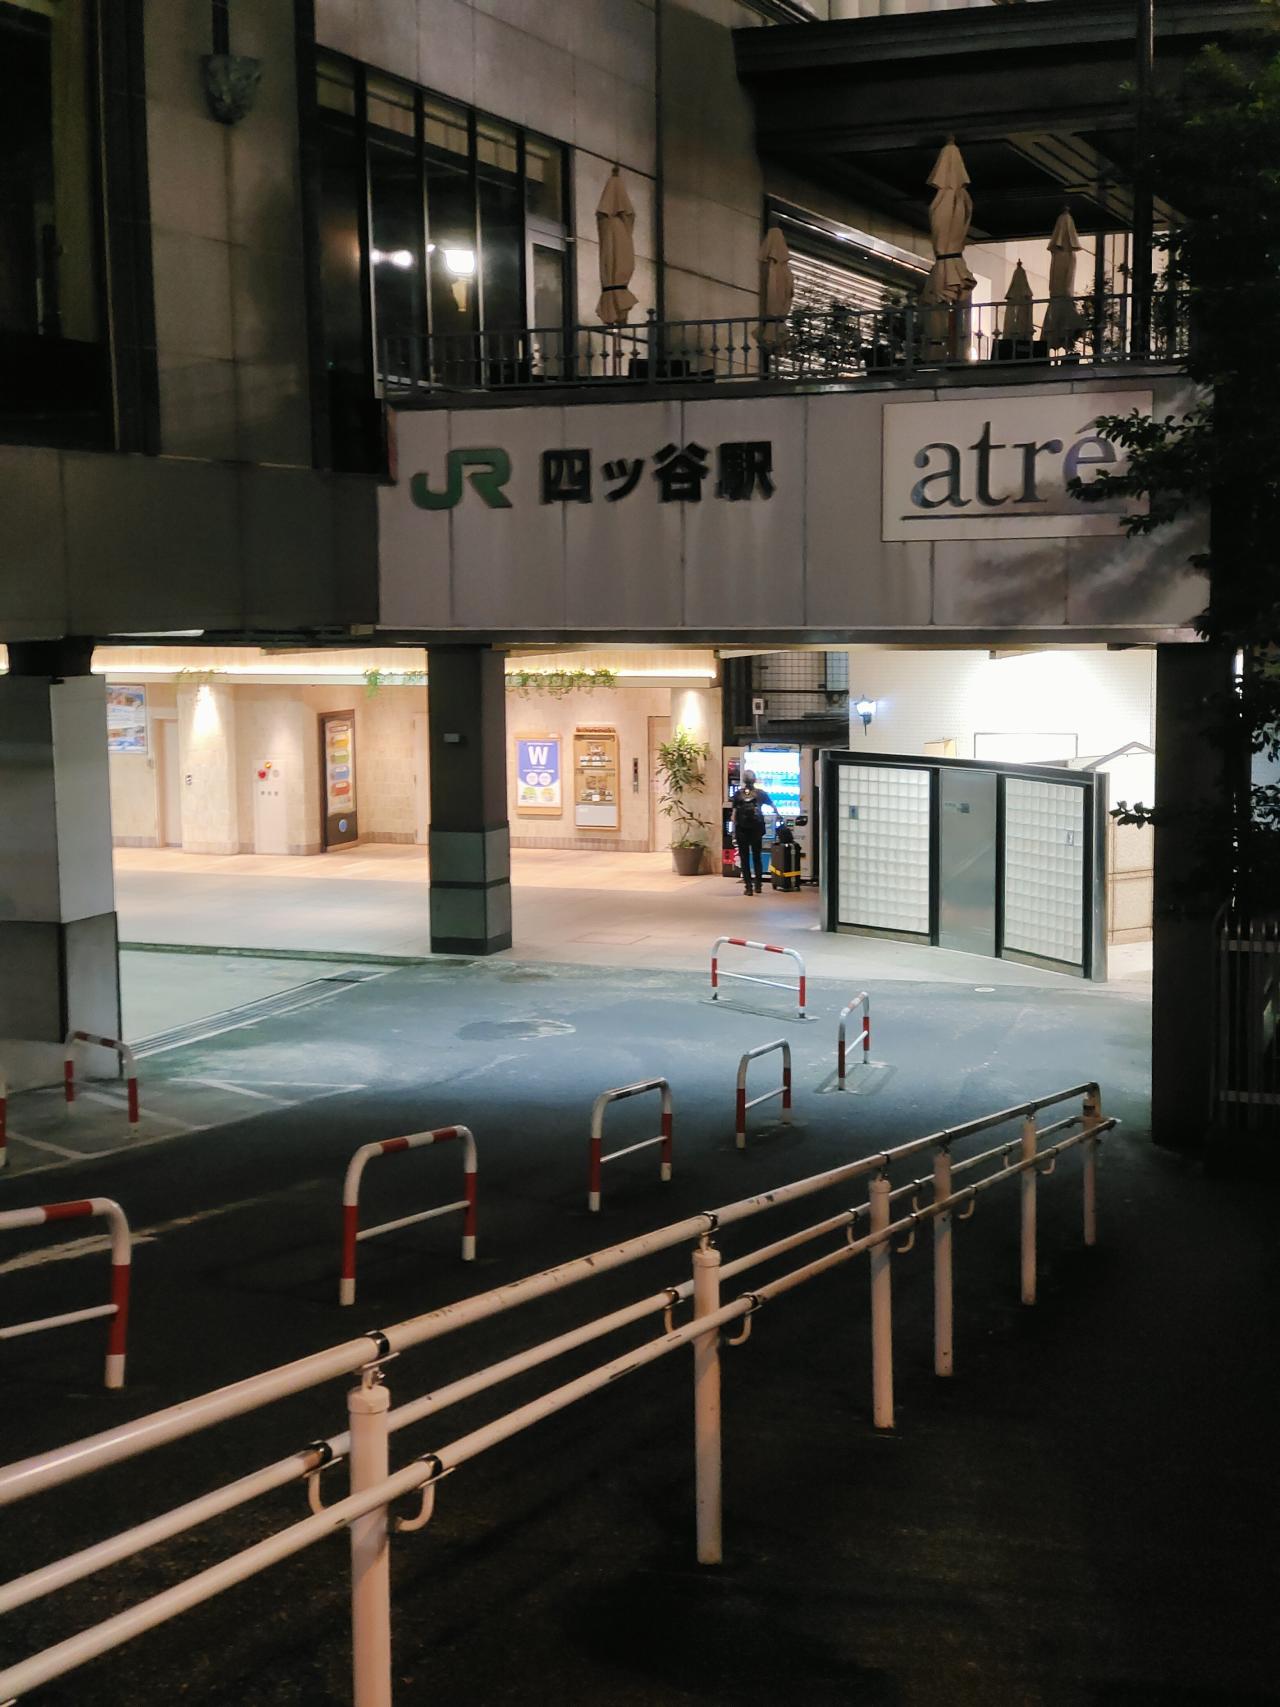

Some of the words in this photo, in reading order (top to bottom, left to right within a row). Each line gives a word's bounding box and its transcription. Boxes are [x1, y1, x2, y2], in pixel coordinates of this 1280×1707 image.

[411, 446, 512, 510] JR
[540, 441, 776, 504] 四ッ谷駅
[911, 419, 1117, 508] atré
[527, 745, 549, 766] W
